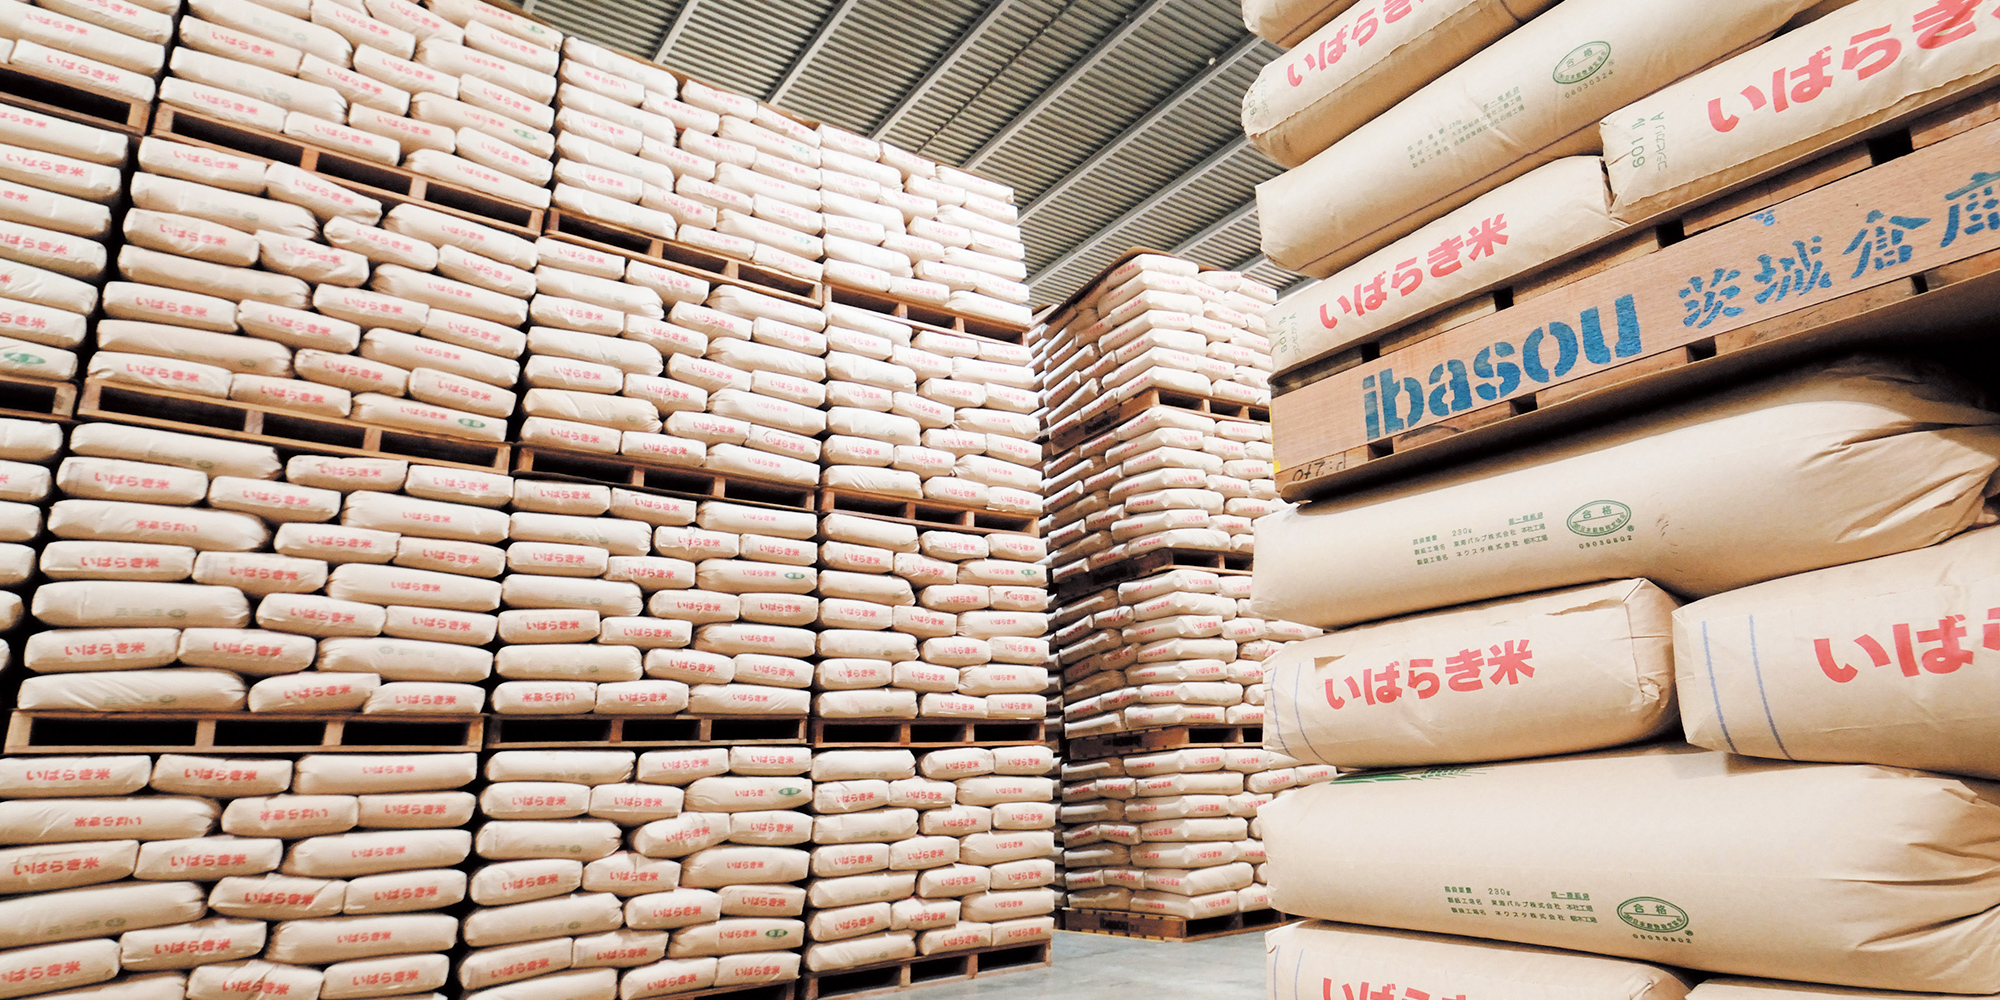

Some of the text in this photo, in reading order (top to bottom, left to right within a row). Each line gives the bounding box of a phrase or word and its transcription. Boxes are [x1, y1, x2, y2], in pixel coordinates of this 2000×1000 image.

[212, 32, 274, 57] いばらき米
[1287, 0, 1424, 87] いばらき
[46, 54, 120, 86] いばらき米
[1708, 0, 2000, 133] いばらき
[327, 64, 386, 94] いばらき米
[191, 92, 258, 118] いばらき米
[377, 113, 431, 136] いばらき米
[311, 121, 373, 147] いばらき米
[6, 154, 84, 177] いばらき米
[173, 147, 239, 170] いばらき米
[291, 176, 357, 206] いばらき米
[159, 223, 230, 245] いばらき米
[282, 241, 344, 264] いばらき米
[1320, 213, 1509, 329] いばらき米
[135, 297, 207, 317] いばらき米
[344, 297, 402, 314] いばらき米
[268, 311, 334, 335] いばらき米
[448, 319, 504, 342] いばらき米
[126, 364, 199, 382] いばらき米
[324, 361, 383, 381] いばらき米
[1362, 293, 1642, 442] ibasou
[260, 386, 324, 404] いばらき米
[438, 381, 491, 401] いばらき米
[400, 408, 447, 420] いばらき米
[550, 428, 599, 444] いばらき米
[320, 465, 381, 478] いばらき米
[94, 472, 169, 489] いばらき米
[433, 477, 489, 491] いばらき米
[243, 490, 309, 506] いばらき米
[540, 490, 590, 499] いばらき米
[402, 513, 451, 523] いばらき米
[1582, 505, 1612, 519] 合格
[308, 536, 371, 548] いばらき米
[81, 557, 159, 568] いばらき米
[422, 549, 479, 564] いばらき米
[533, 553, 585, 563] いばらき米
[230, 567, 298, 580] いばらき米
[628, 568, 674, 578] いばらき米
[391, 582, 440, 592] いばらき米
[290, 608, 355, 623] いばらき米
[412, 617, 471, 631] いばらき米
[526, 621, 579, 630] いばらき米
[624, 628, 671, 638] いばらき米
[65, 643, 145, 655] いばらき米
[213, 642, 282, 657] いばらき米
[1813, 607, 2000, 683] いば
[1325, 639, 1535, 709] いばらき米
[284, 685, 351, 699] いばらき米
[619, 693, 667, 702] いばらき米
[395, 695, 456, 705] いばらき米
[363, 765, 415, 774] いばらき米
[662, 759, 709, 769] いばらき米
[26, 769, 110, 781] いばらき米
[184, 769, 257, 781] いばらき米
[512, 796, 566, 806] いばらき米
[614, 797, 662, 807] いばらき米
[384, 804, 446, 815] いばらき米
[352, 846, 405, 858] いばらき米
[13, 857, 99, 876] いばらき米
[171, 854, 246, 867] いばらき米
[502, 874, 558, 890] いばらき米
[610, 871, 658, 881] いばらき米
[244, 892, 314, 905] いばらき米
[374, 886, 437, 901] いばらき米
[653, 906, 701, 918] いばらき米
[1633, 903, 1667, 915] 合格
[337, 932, 391, 943] いばらき米
[154, 939, 231, 955] いばらき米
[596, 947, 647, 960] いばらき米
[491, 958, 549, 978] いばらき米
[352, 970, 418, 986] いばらき米
[647, 973, 696, 990] いばらき米
[222, 981, 289, 995] いばらき米
